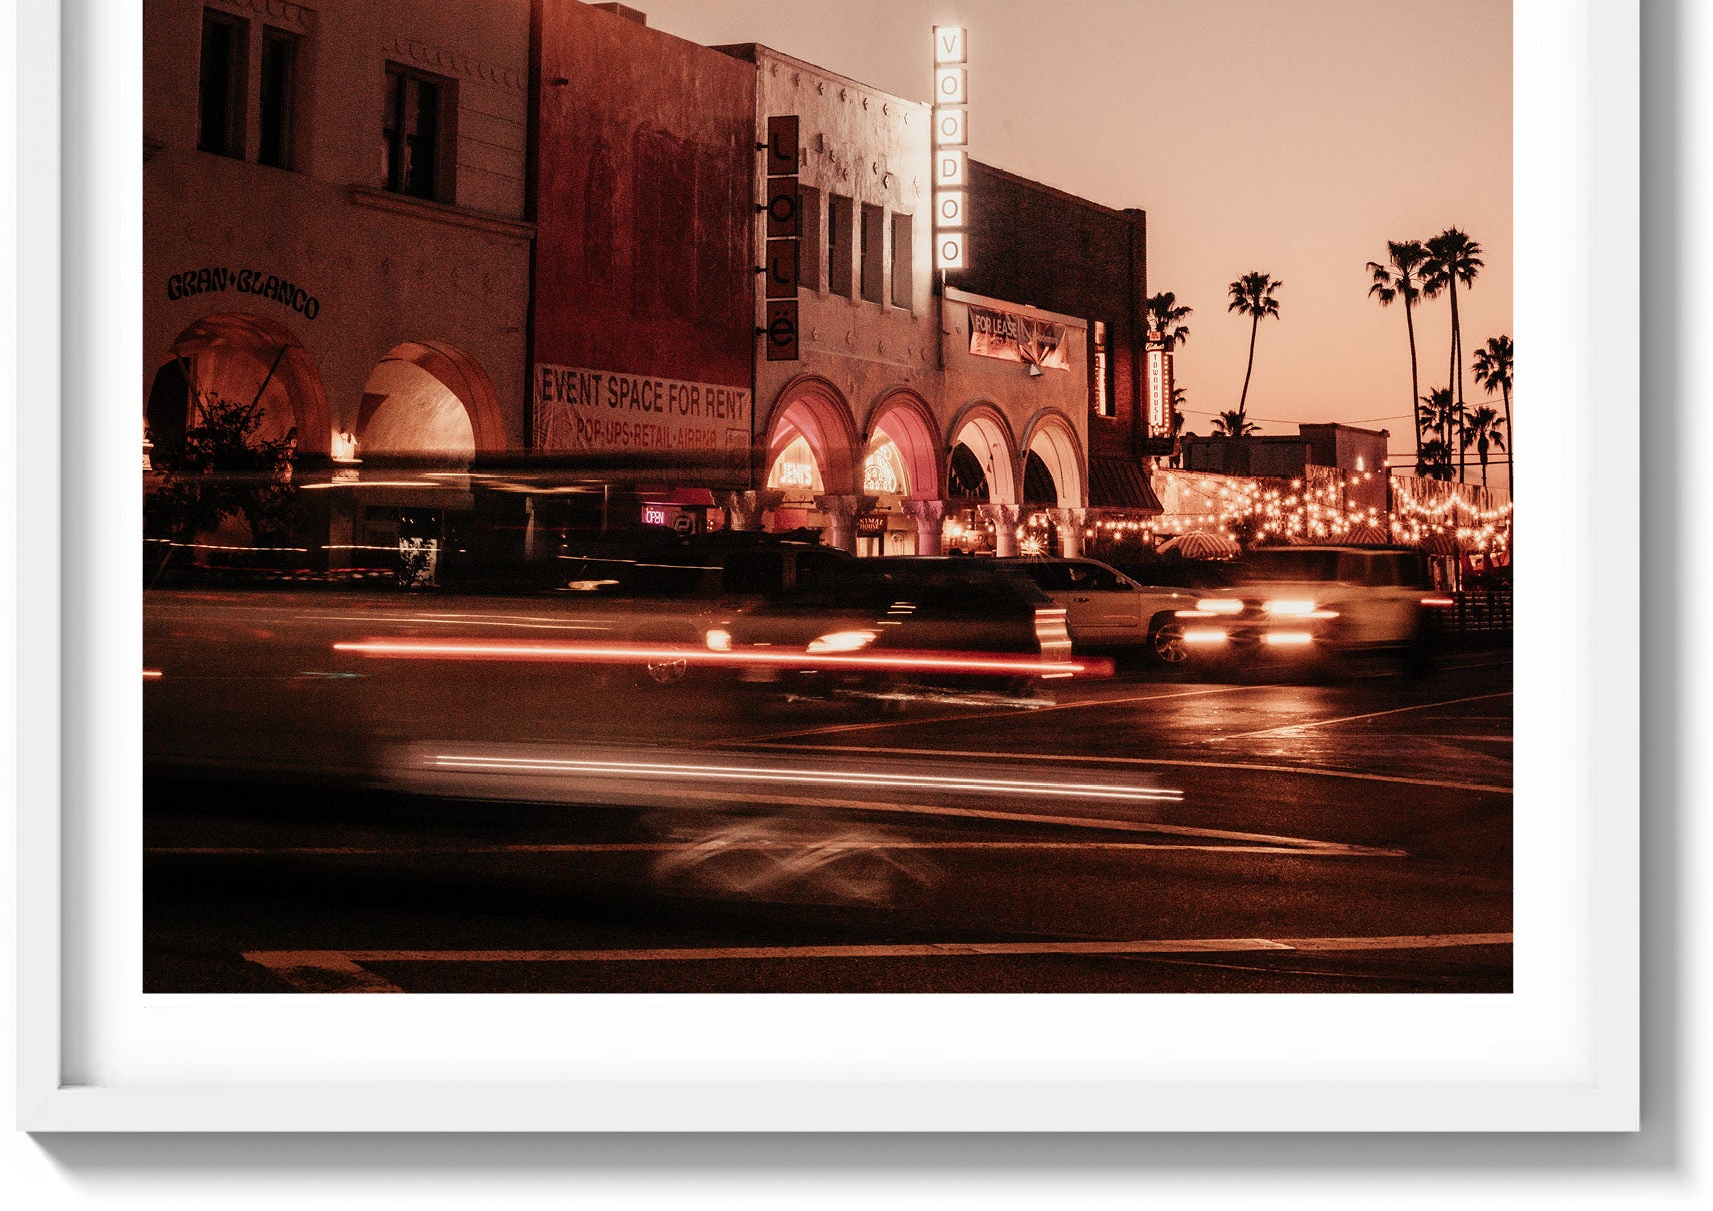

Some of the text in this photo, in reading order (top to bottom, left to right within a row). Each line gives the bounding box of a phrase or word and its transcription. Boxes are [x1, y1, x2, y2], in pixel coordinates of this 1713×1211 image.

[941, 35, 959, 261] VOODOO
[167, 267, 320, 320] GRAN BLANCO
[975, 314, 1017, 338] FOR LEASE
[542, 367, 746, 421] EVENT SPACE FOR RENT
[576, 417, 630, 446] POP-UPS
[634, 423, 673, 449] RETAIL
[646, 510, 665, 524] OPEN
